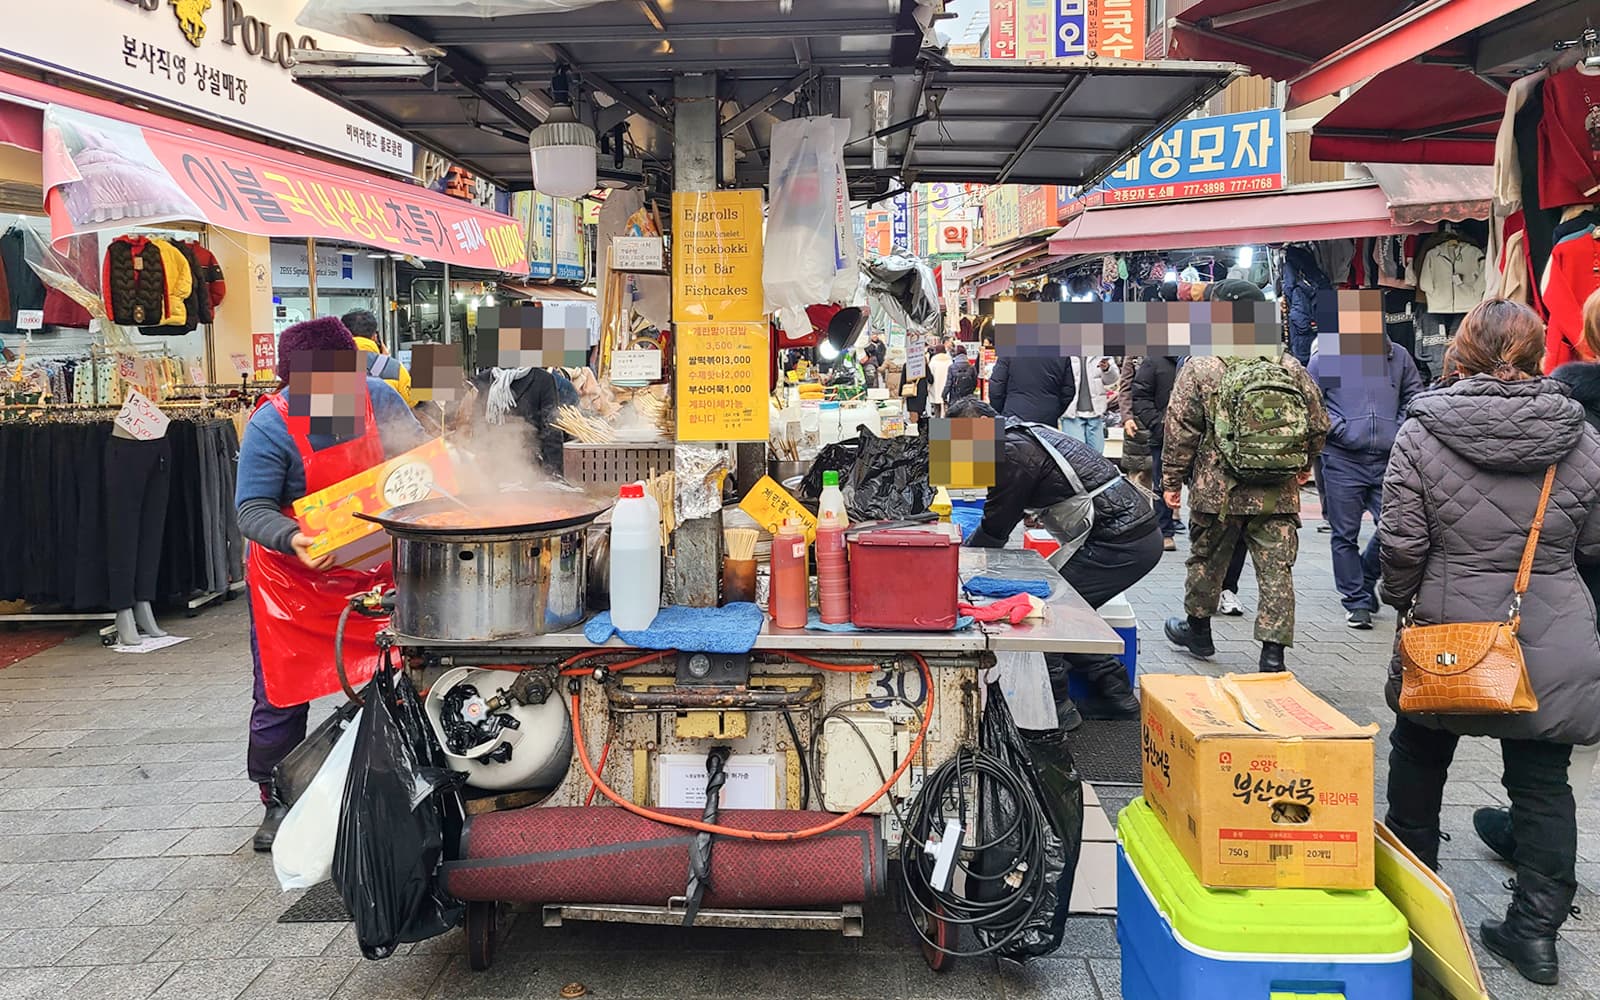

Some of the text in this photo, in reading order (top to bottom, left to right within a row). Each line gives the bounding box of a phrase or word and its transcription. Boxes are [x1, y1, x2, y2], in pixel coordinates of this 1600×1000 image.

[221, 0, 295, 69] POLO
[122, 35, 248, 105] 본사직영 상설매장
[1113, 187, 1145, 201] 각종모자
[1183, 181, 1225, 196] 777-3898
[1231, 177, 1272, 192] 777-1768
[182, 153, 291, 223] 이불
[263, 171, 400, 244] 국내생산
[385, 198, 455, 255] 초특가
[684, 208, 738, 222] Eggrolls
[944, 226, 968, 248] 약
[685, 262, 735, 274] Hot Bar
[685, 284, 748, 296] Fishcakes
[688, 385, 752, 394] 부산어묵1,000
[689, 399, 743, 409] 계좌이체가능
[689, 414, 716, 424] 합니다
[865, 668, 928, 708] 30
[1233, 772, 1359, 806] 부산어묵 튀김어묵
[1306, 849, 1331, 859] 20개입
